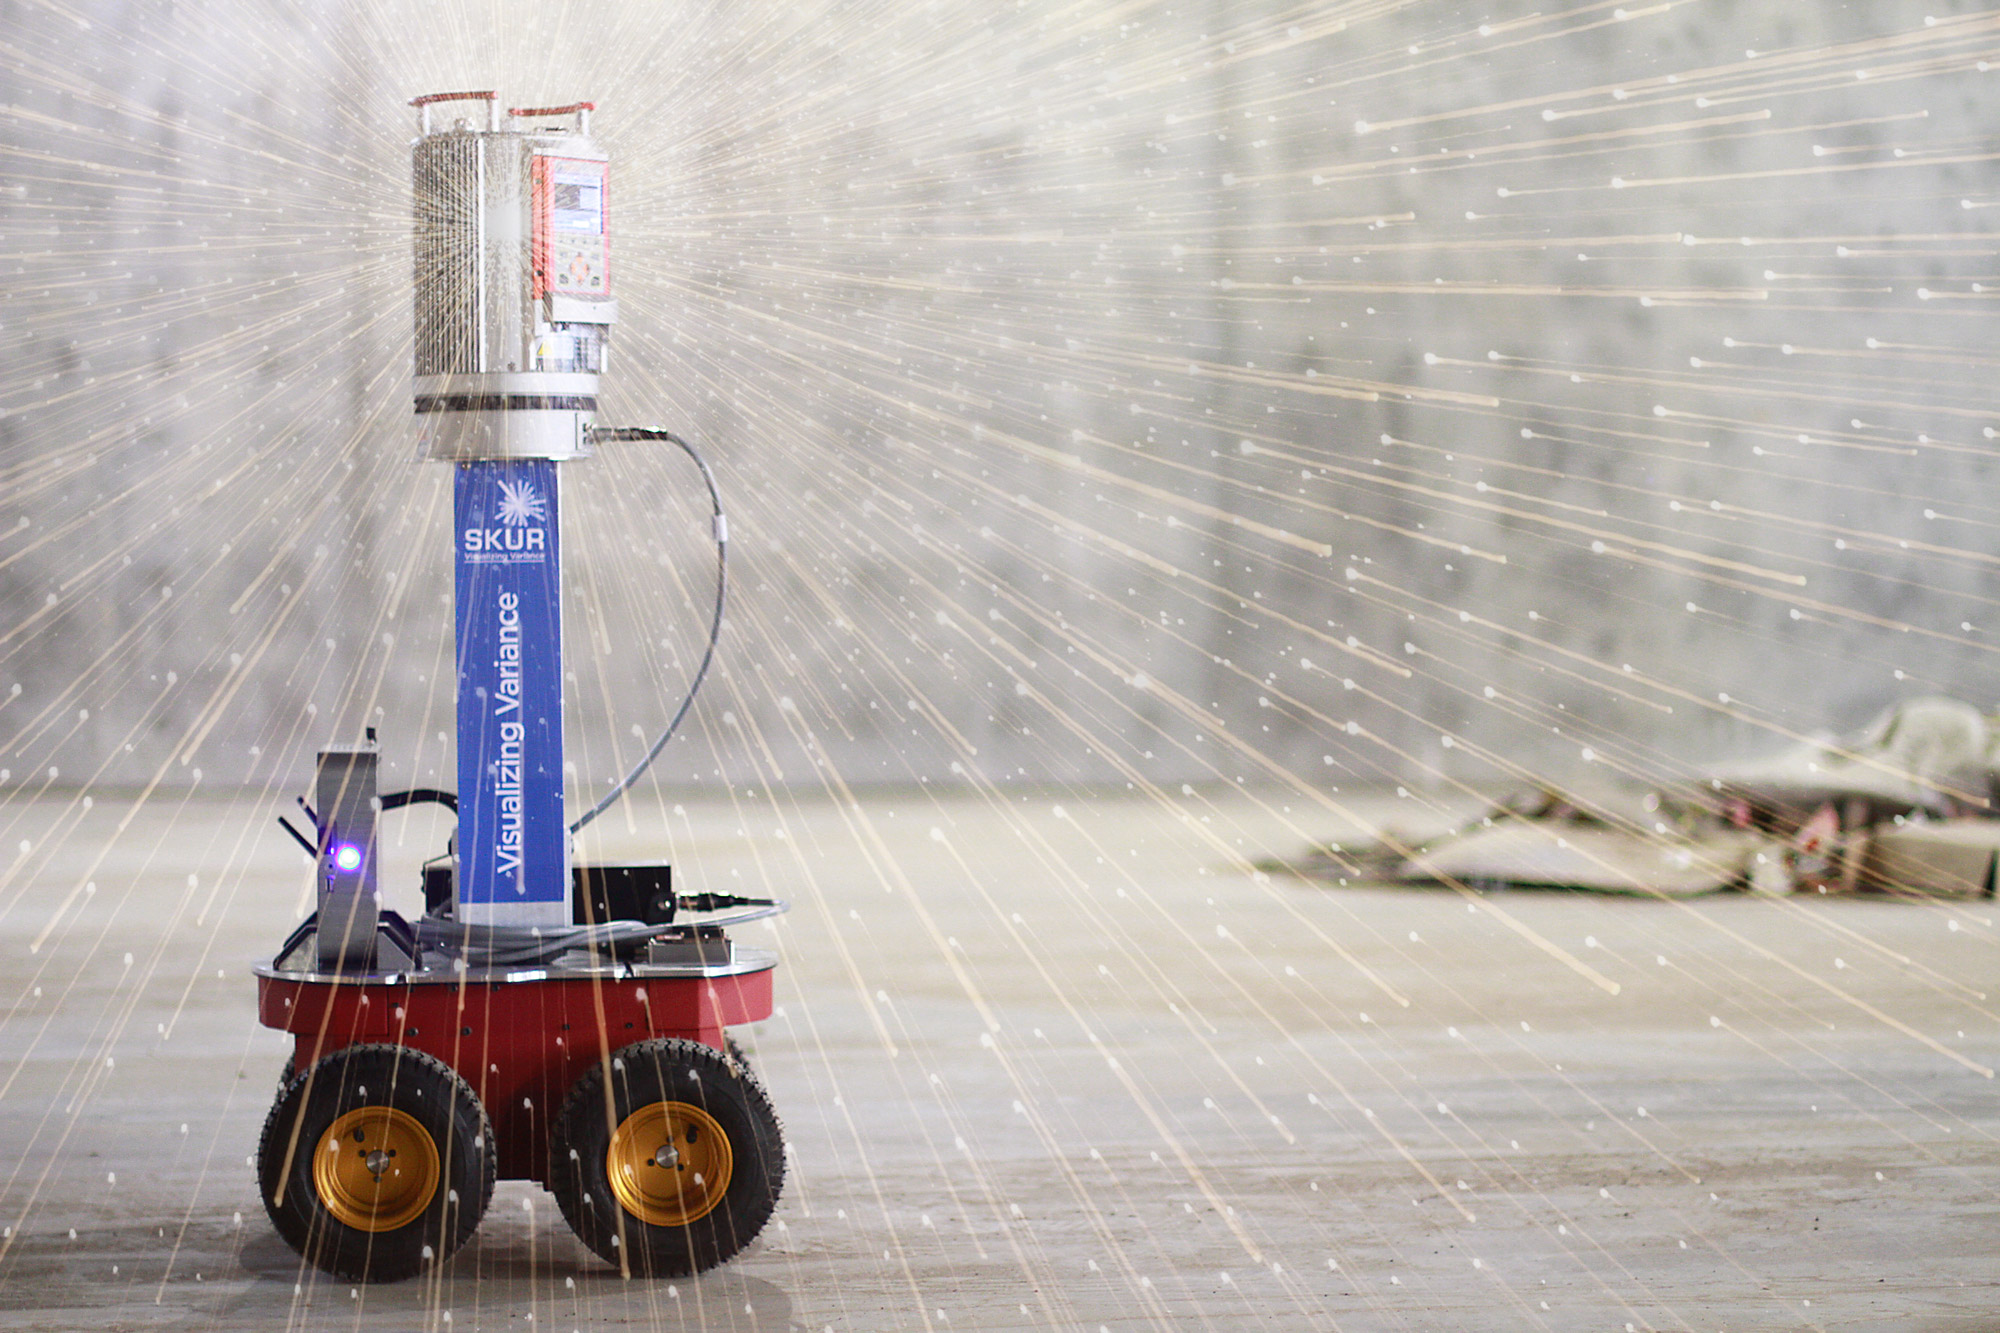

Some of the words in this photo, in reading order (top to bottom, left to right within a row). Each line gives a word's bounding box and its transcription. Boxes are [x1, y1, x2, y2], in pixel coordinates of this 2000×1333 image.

[464, 528, 545, 551] SKUR
[464, 552, 508, 561] Vializing
[493, 592, 520, 716] Variance
[496, 722, 524, 874] Visualizing
